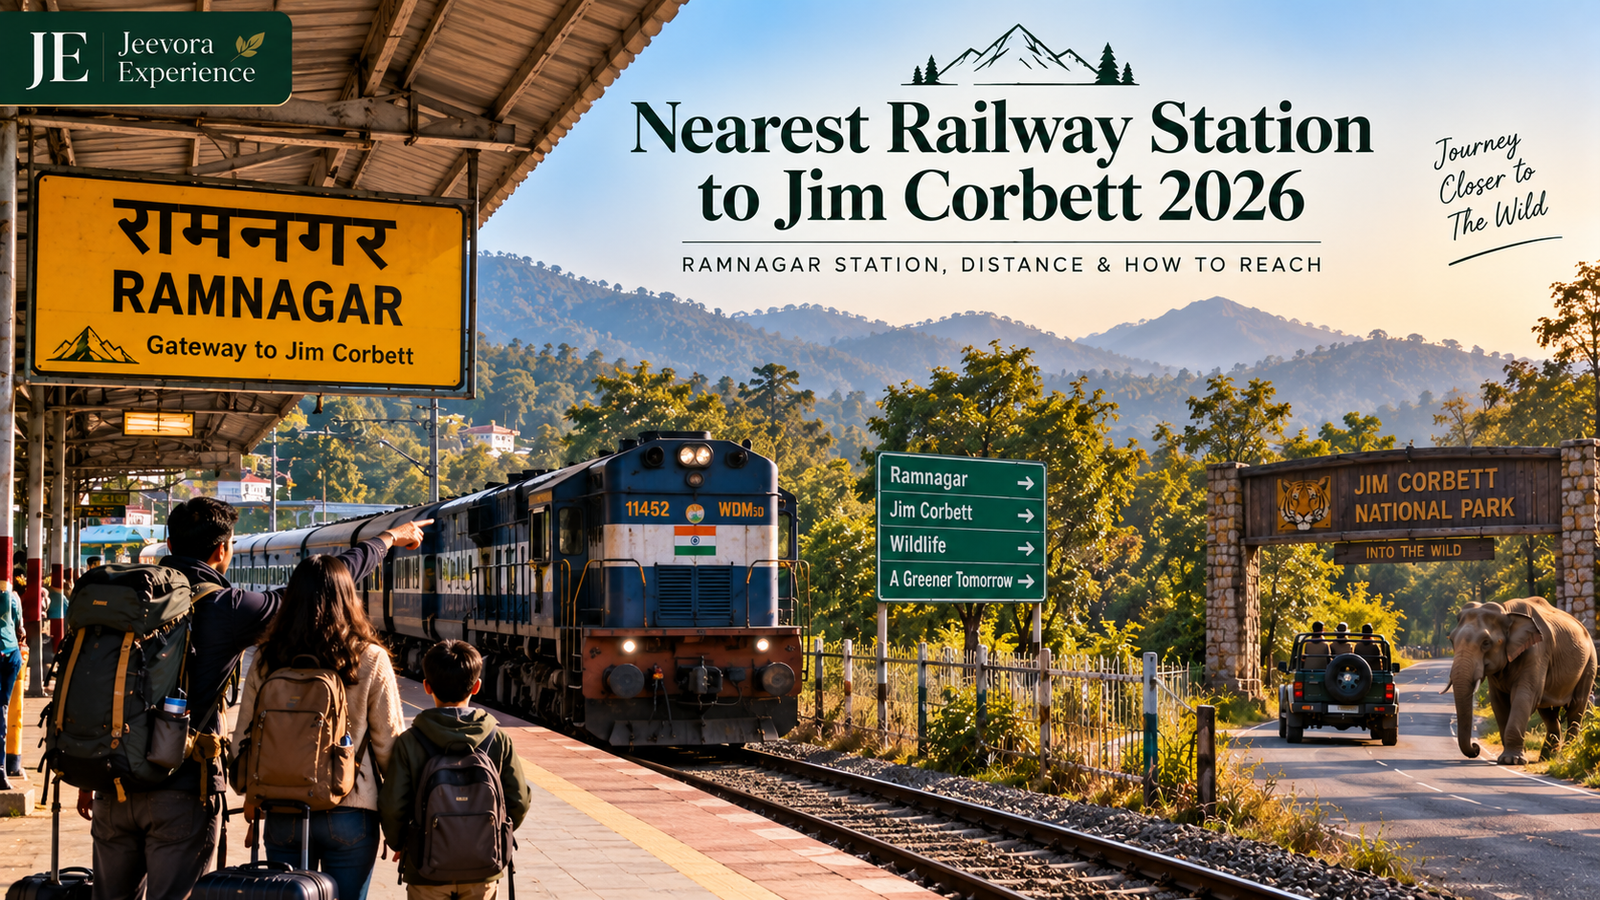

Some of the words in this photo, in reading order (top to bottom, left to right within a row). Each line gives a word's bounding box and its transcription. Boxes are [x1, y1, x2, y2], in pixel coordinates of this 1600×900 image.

[112, 198, 397, 270] रामनगर
[112, 269, 403, 327] RAMNAGAR
[146, 335, 247, 362] Gateway
[255, 340, 278, 359] to
[285, 341, 325, 361] Jim
[333, 343, 414, 365] Corbett
[890, 466, 968, 490] Ramnagar
[1354, 474, 1388, 495] JIM
[1397, 467, 1498, 493] CORBETT
[625, 501, 670, 517] 11452
[890, 500, 916, 518] Jim
[920, 501, 973, 521] Corbett
[1355, 500, 1453, 523] NATIONAL
[1461, 497, 1516, 519] PARK
[890, 534, 947, 553] Wildlife
[1366, 545, 1395, 559] INTO
[1400, 545, 1425, 558] THE
[1430, 543, 1462, 557] WILD
[889, 570, 899, 587] A
[903, 570, 953, 588] Greener
[956, 571, 1013, 588] Tomorrow
